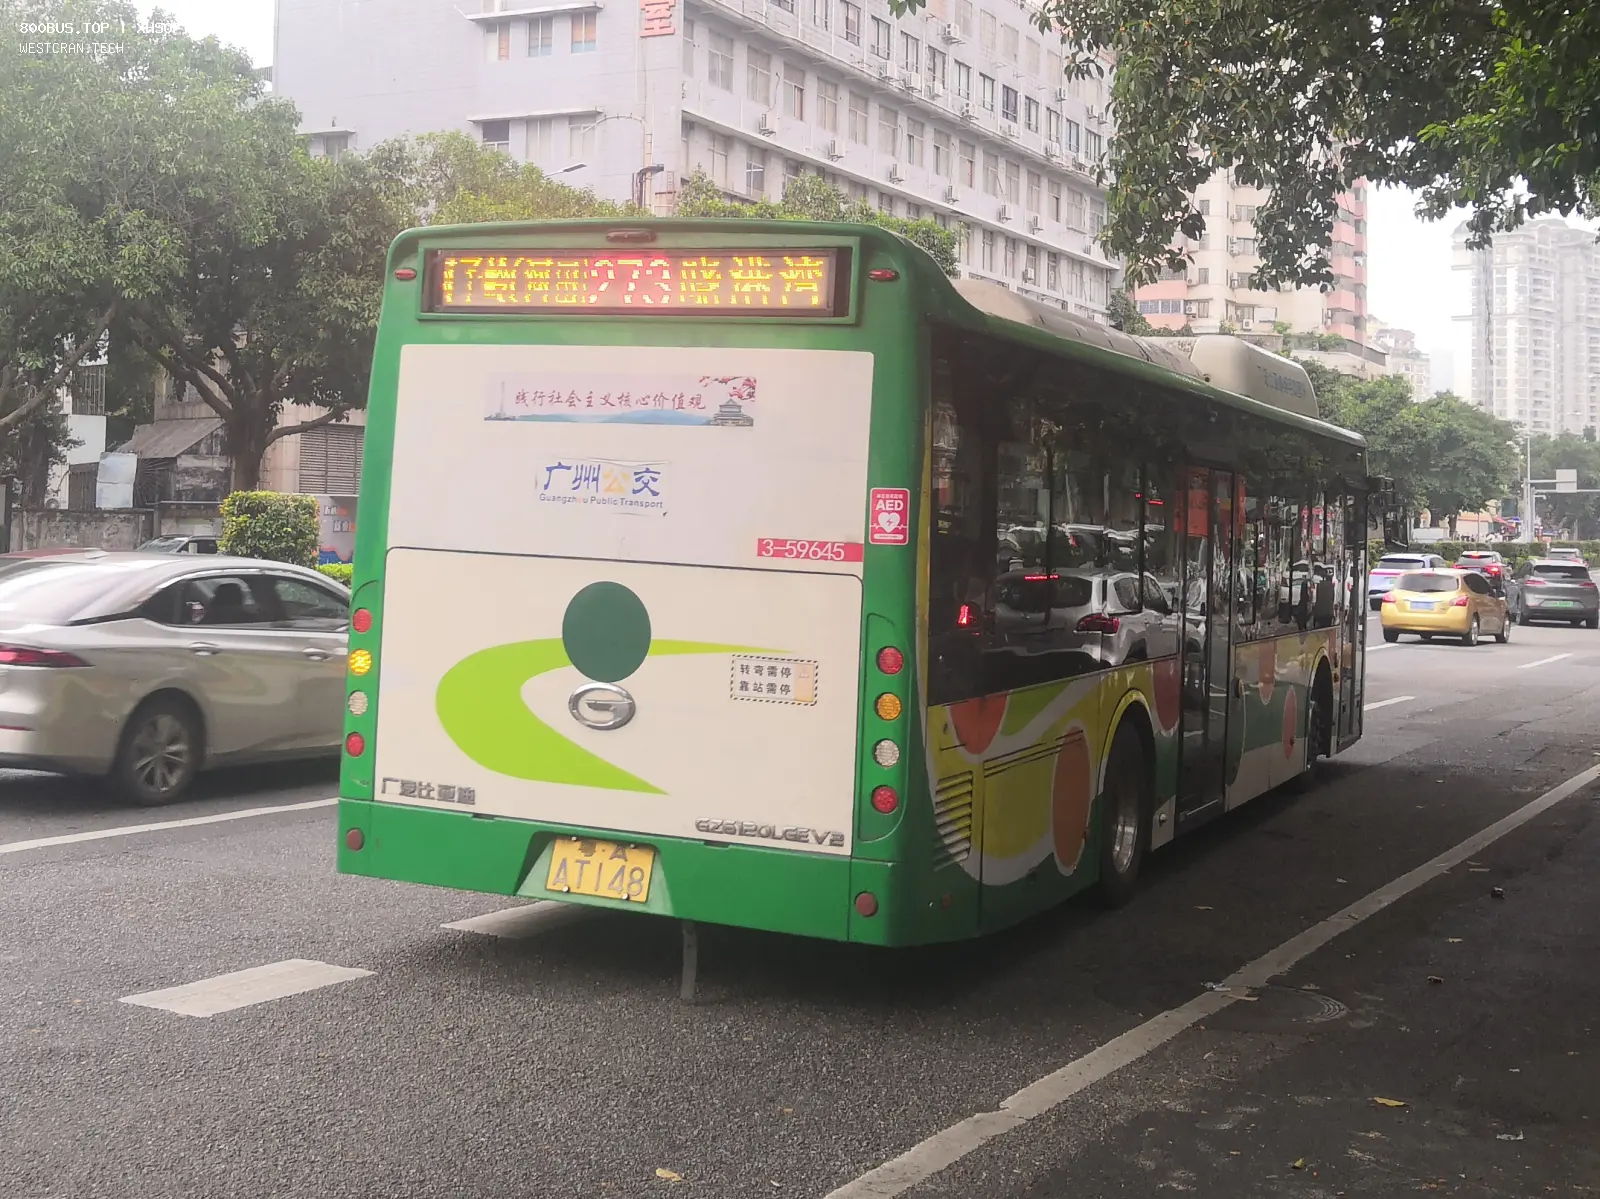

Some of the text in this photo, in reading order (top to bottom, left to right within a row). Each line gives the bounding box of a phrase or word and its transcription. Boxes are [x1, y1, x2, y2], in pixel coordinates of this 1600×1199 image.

[588, 257, 671, 305] 273
[515, 389, 706, 411] 践行社会主义核心价值观
[543, 461, 661, 497] 广州公交
[539, 493, 664, 509] Guangzhou Public Transport
[875, 499, 904, 511] AED
[761, 538, 845, 561] 3-59645
[739, 664, 791, 679] 转弯需停
[739, 680, 791, 696] 靠站需停
[552, 857, 646, 897] AT148
